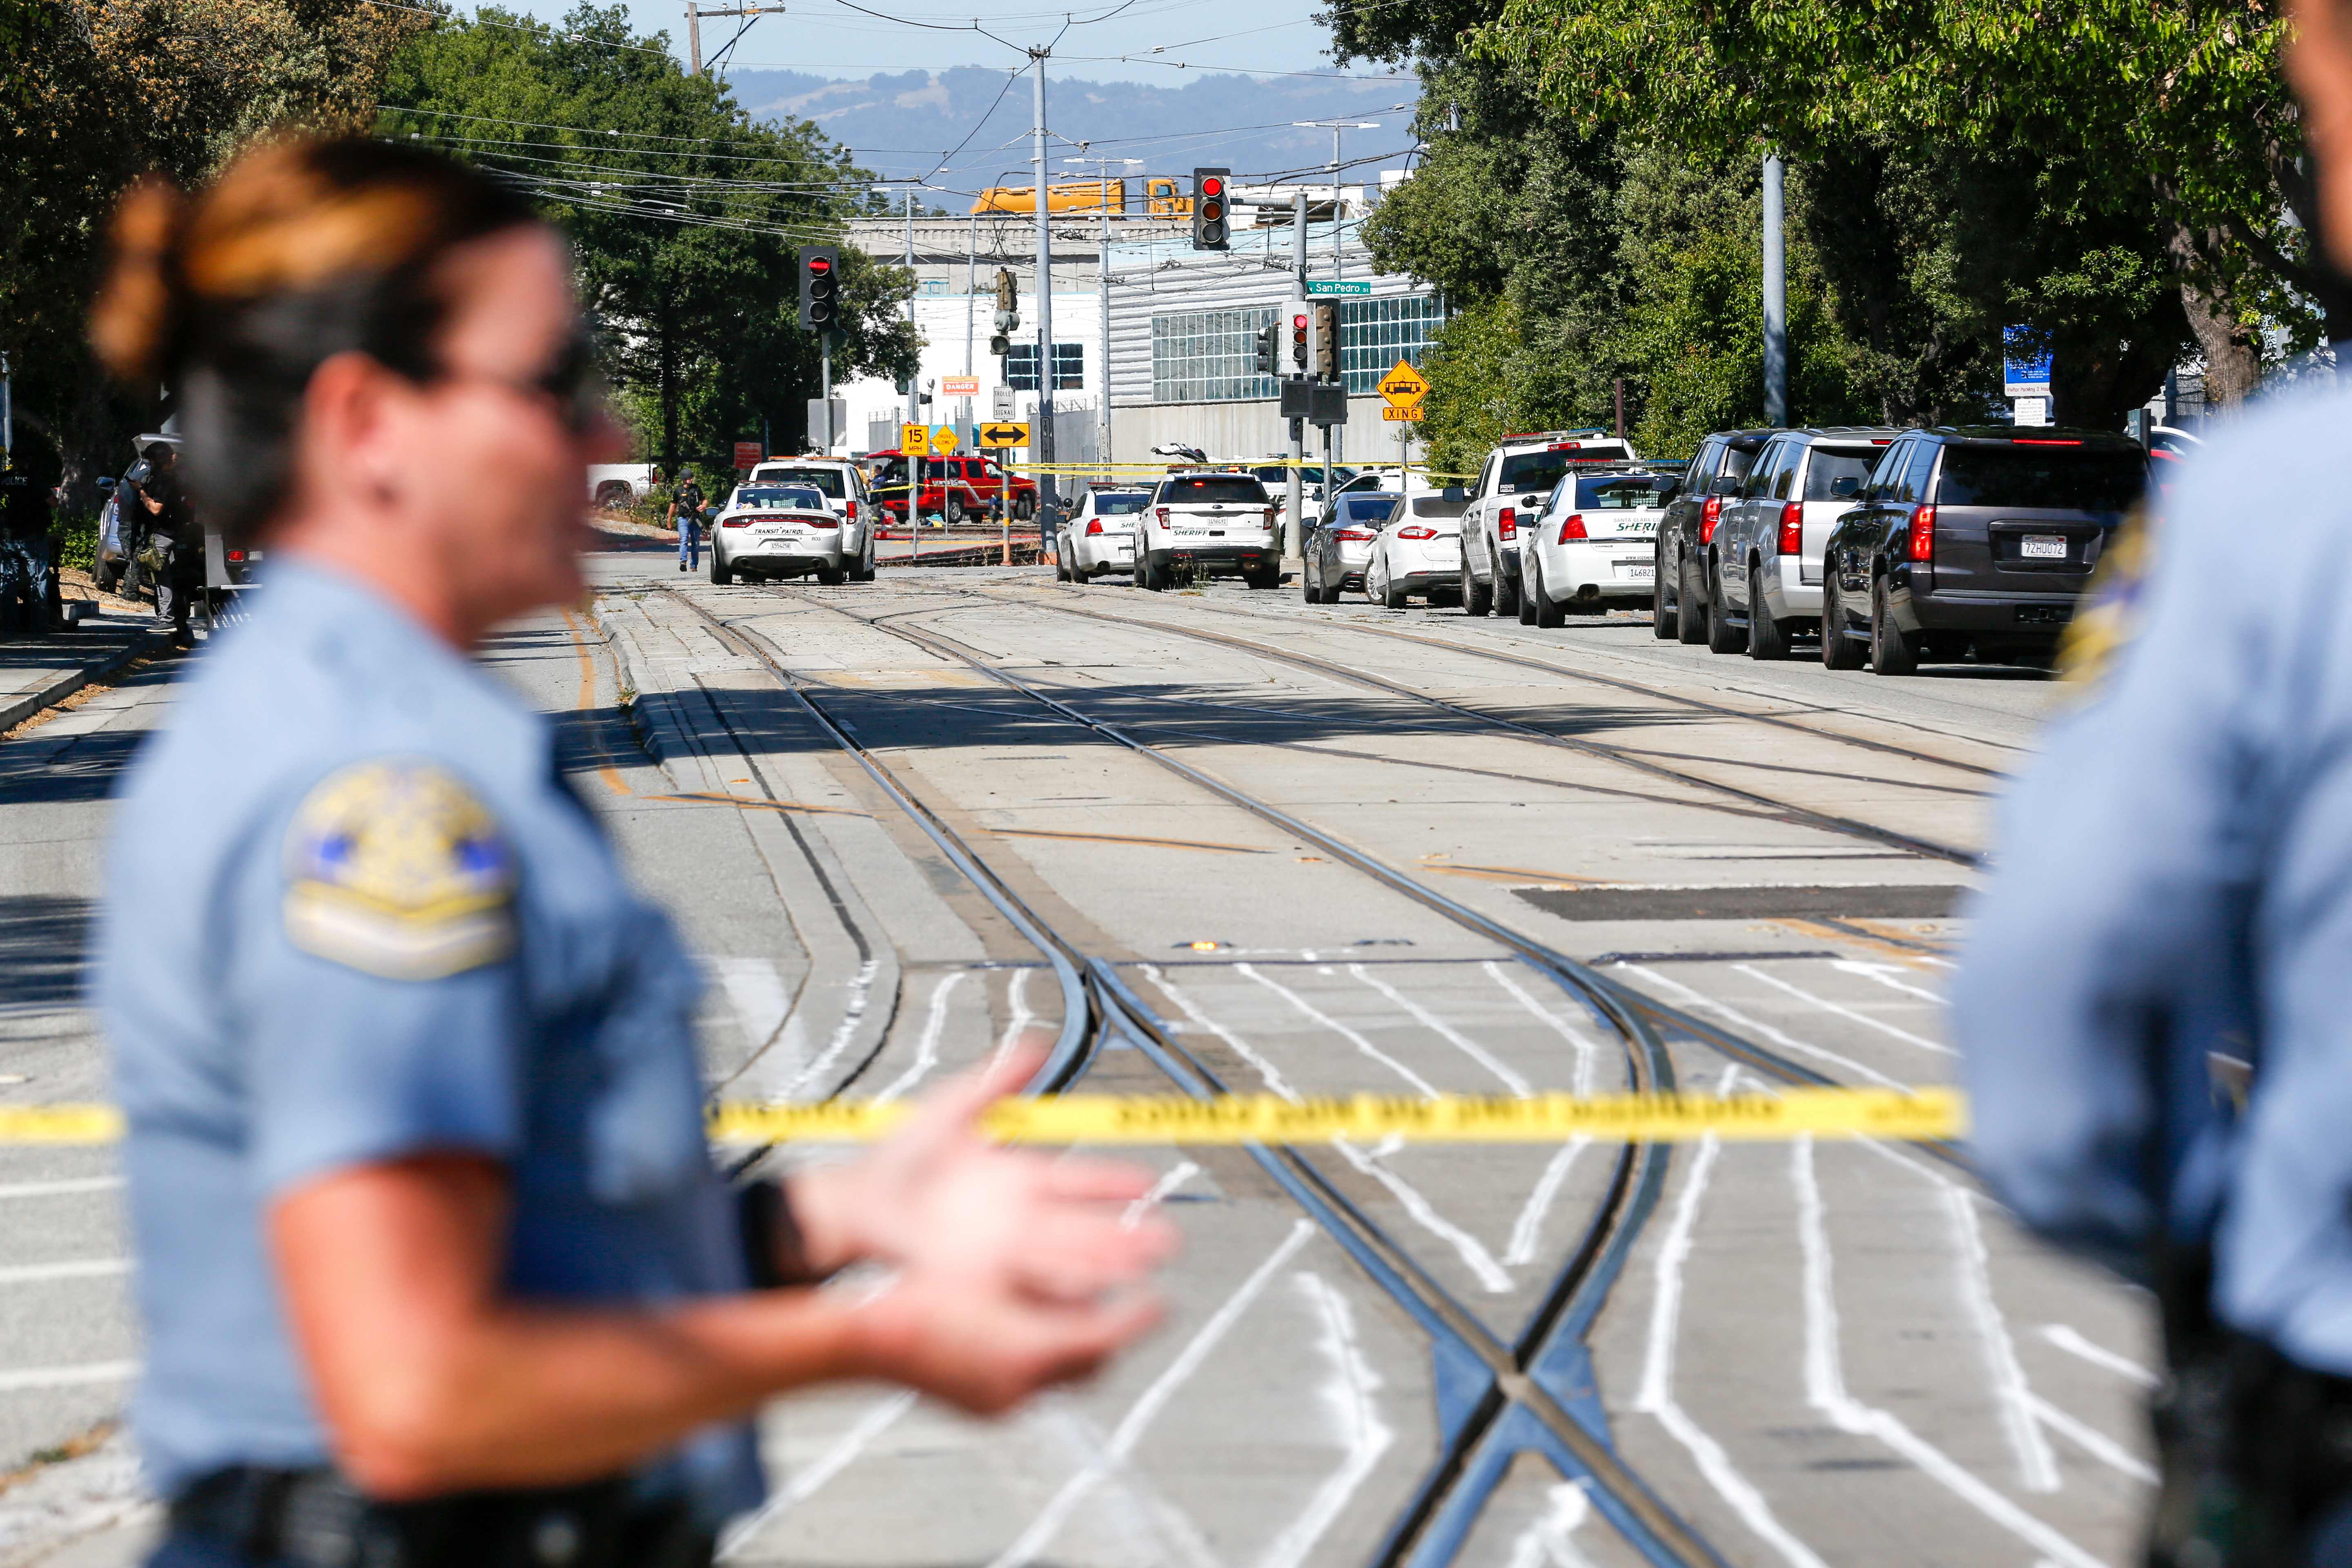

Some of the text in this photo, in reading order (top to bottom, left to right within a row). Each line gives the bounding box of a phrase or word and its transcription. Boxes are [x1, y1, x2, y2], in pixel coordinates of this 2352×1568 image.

[1316, 283, 1332, 292] San
[1335, 284, 1360, 292] Pedro
[1389, 409, 1417, 419] XING
[908, 430, 922, 443] 15
[2026, 543, 2063, 554] 7ZHU072
